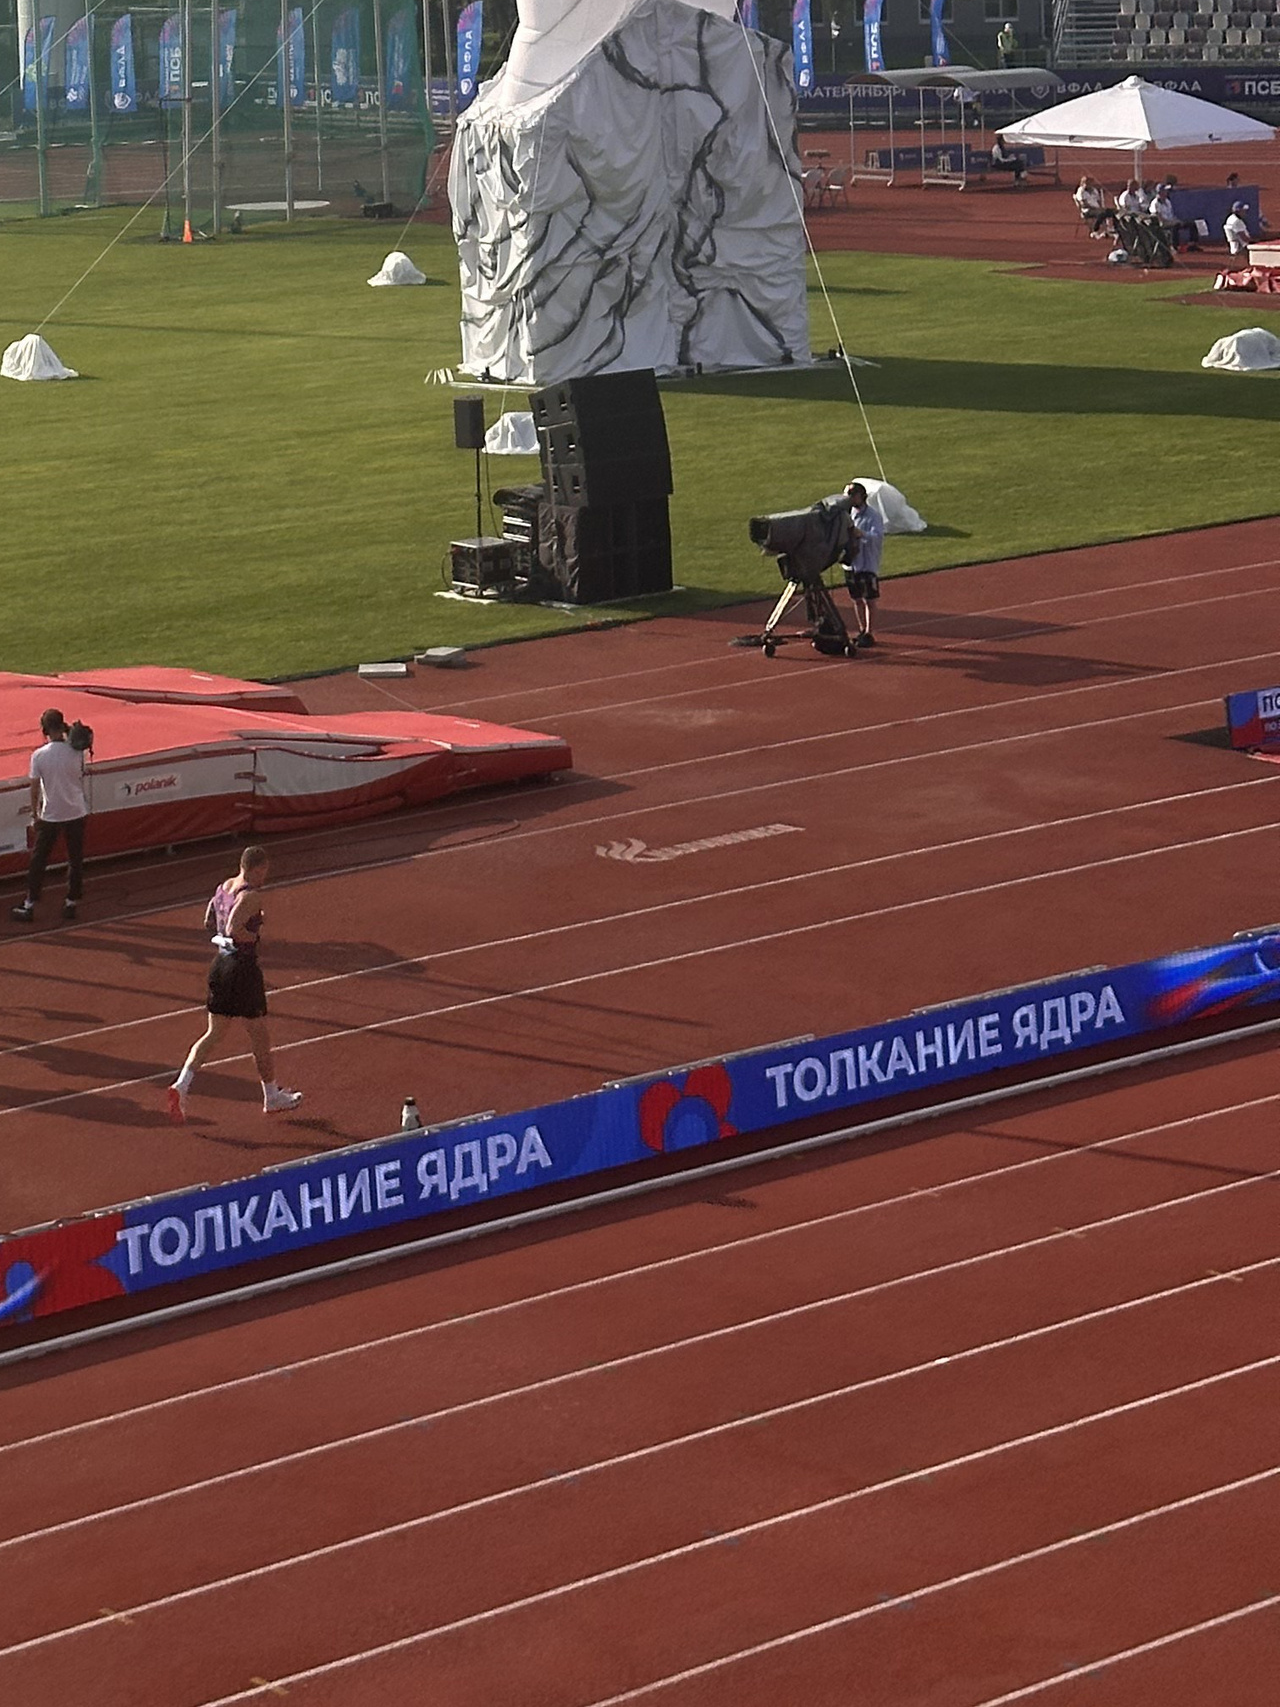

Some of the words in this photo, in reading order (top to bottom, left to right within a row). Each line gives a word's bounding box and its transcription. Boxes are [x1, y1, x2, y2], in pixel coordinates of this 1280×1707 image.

[135, 775, 177, 795] polanik
[765, 1012, 1002, 1108] ТОЛКАНИЕ
[1012, 984, 1125, 1051] ЯДРА
[116, 1159, 404, 1275] ТОЛКАНИЕ
[417, 1124, 552, 1200] ЯДРА
